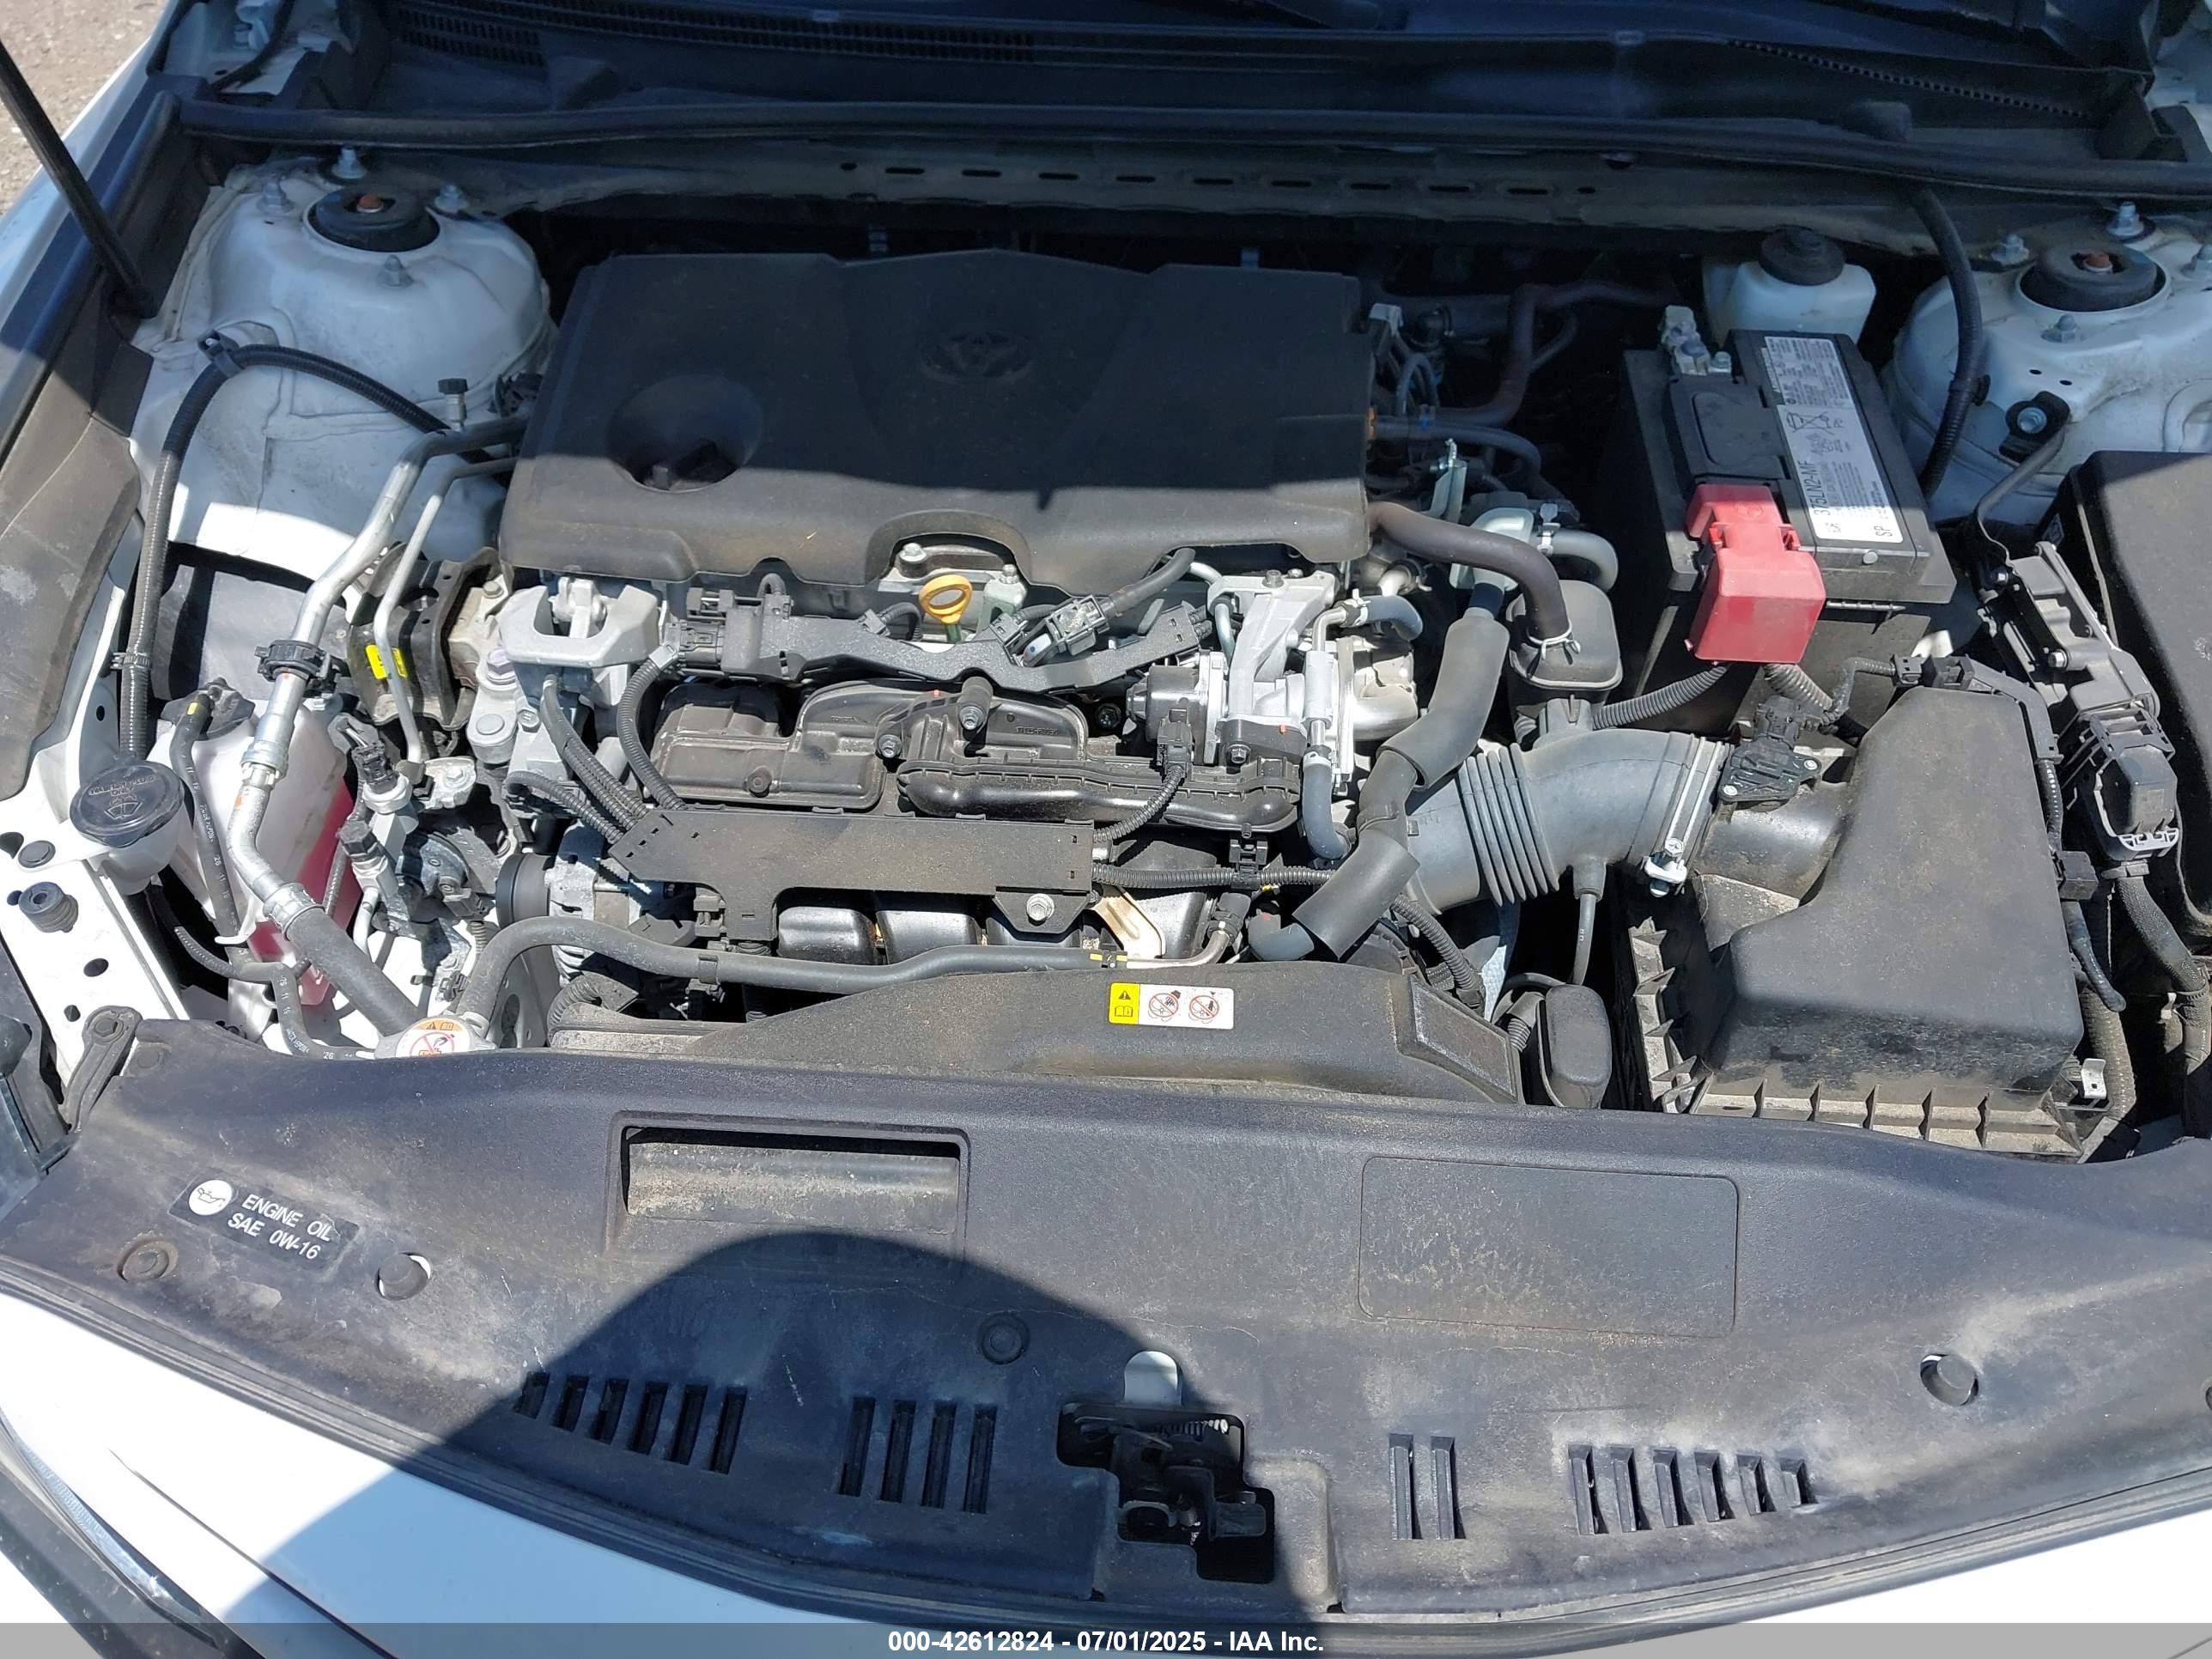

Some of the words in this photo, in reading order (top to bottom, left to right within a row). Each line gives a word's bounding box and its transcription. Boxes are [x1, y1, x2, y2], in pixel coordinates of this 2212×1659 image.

[228, 1213, 265, 1237] SAE
[270, 1229, 321, 1260] 0W-16
[242, 1194, 303, 1228] ENGINE
[307, 1220, 332, 1242] OIL
